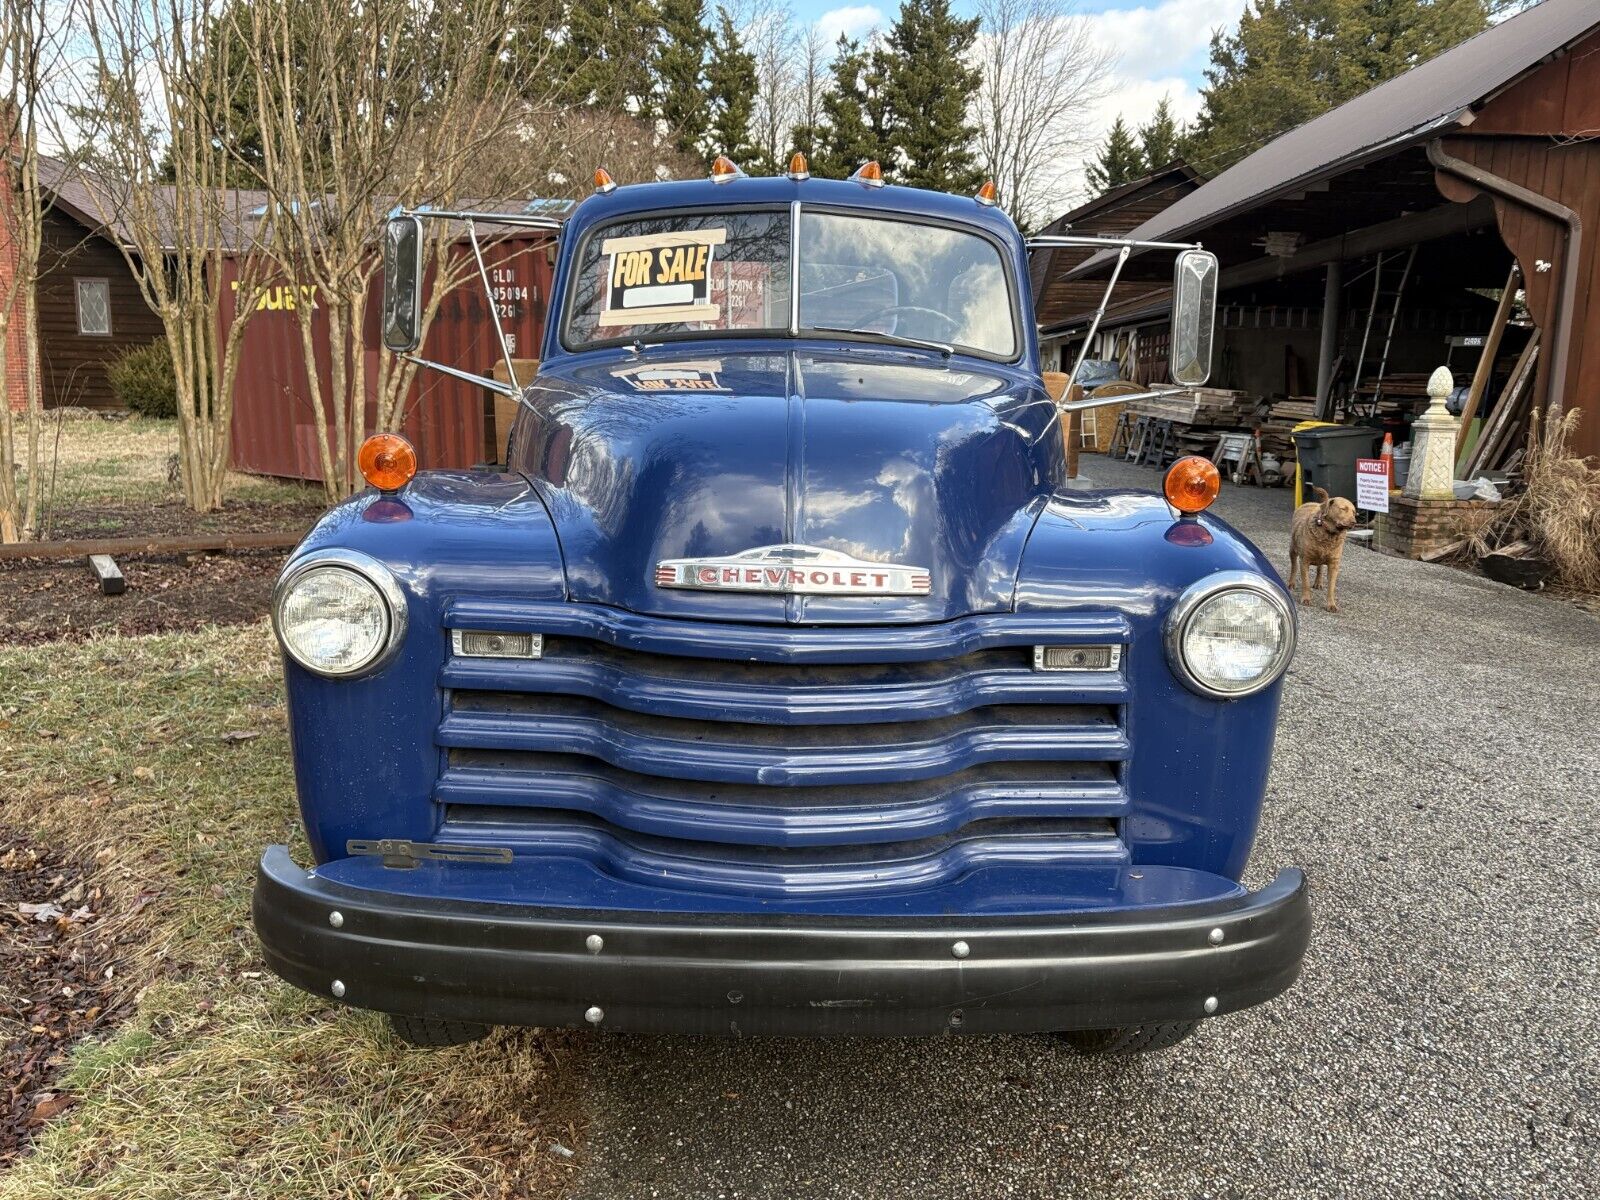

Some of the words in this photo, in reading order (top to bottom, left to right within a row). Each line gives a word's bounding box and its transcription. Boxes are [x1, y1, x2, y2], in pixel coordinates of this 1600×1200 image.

[493, 269, 515, 283] GLD
[614, 251, 653, 288] FOR
[656, 246, 708, 283] SALE
[699, 568, 889, 587] CHEVROLET
